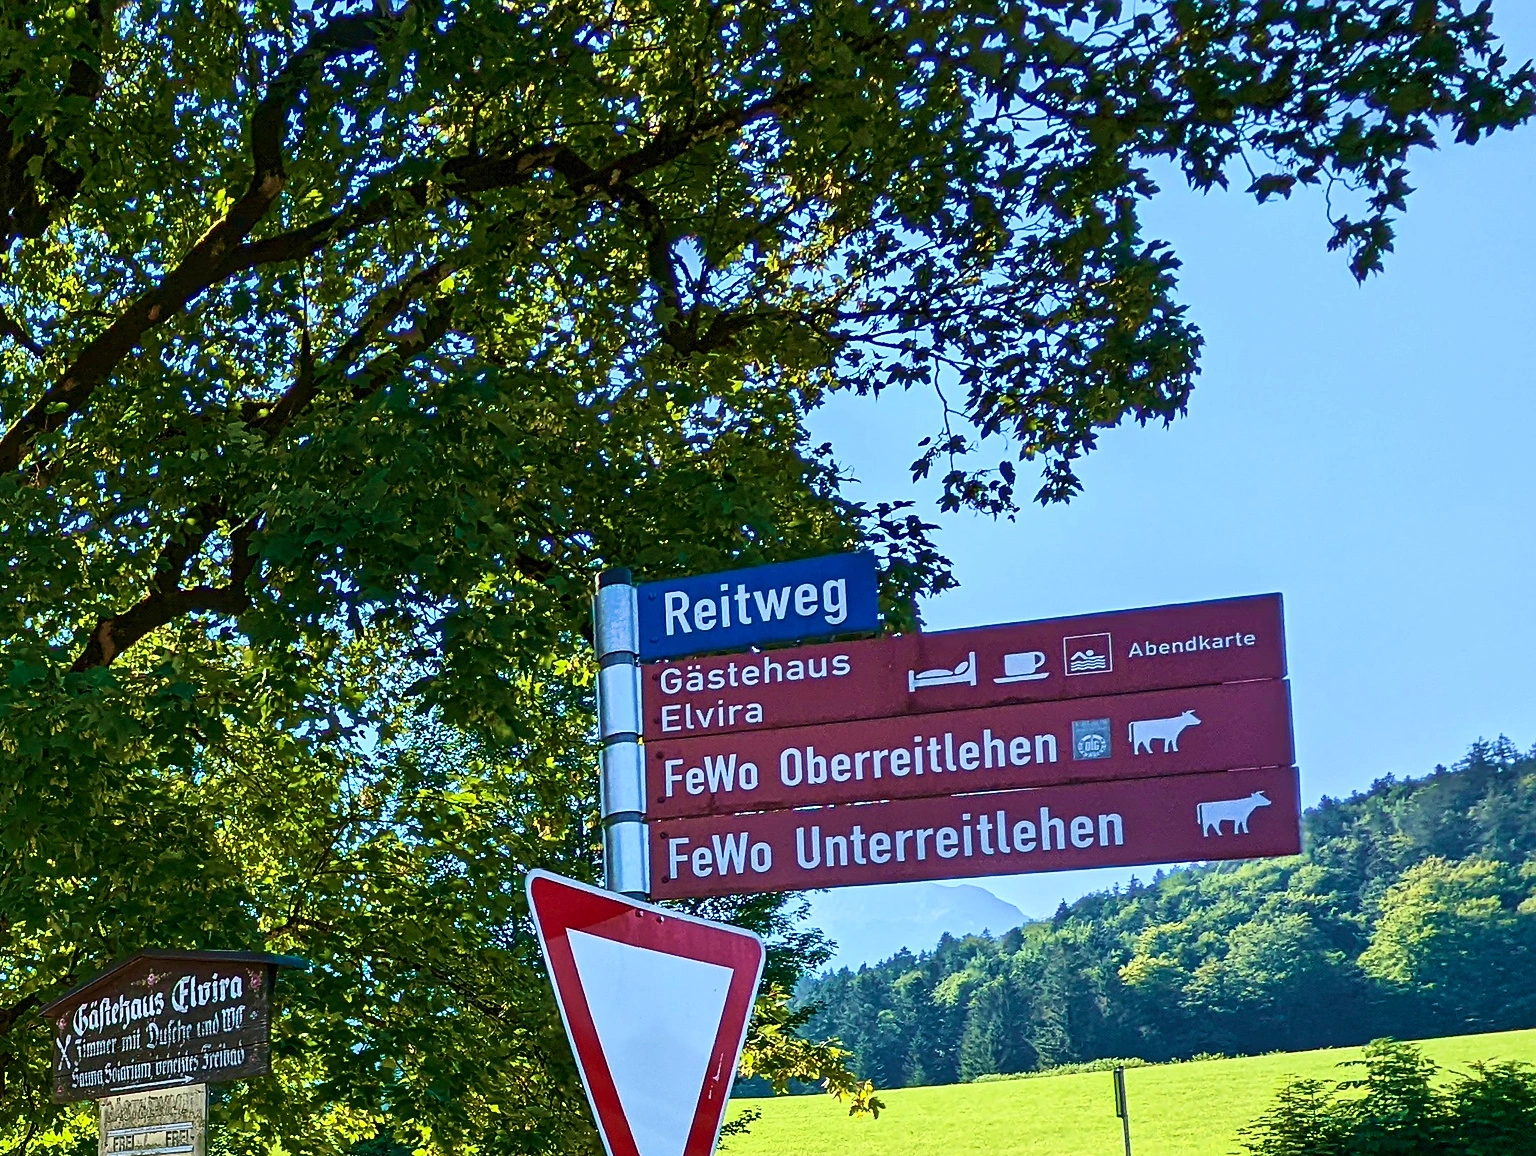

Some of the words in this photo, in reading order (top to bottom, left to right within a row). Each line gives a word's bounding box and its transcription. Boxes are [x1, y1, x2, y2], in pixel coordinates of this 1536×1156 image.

[664, 577, 849, 636] Reitweg
[1127, 630, 1257, 658] Abendkarte
[659, 653, 852, 695] Gästehaus
[660, 699, 764, 732] Elvira
[664, 753, 760, 798] FeWo
[779, 728, 1058, 788] Oberreitlehen
[667, 831, 773, 880] FeWo
[795, 806, 1125, 870] Unterreitlehen
[171, 972, 244, 1013] Elvira
[73, 1034, 118, 1066] Zimmer
[120, 1027, 142, 1052] mit
[195, 1014, 221, 1039] und
